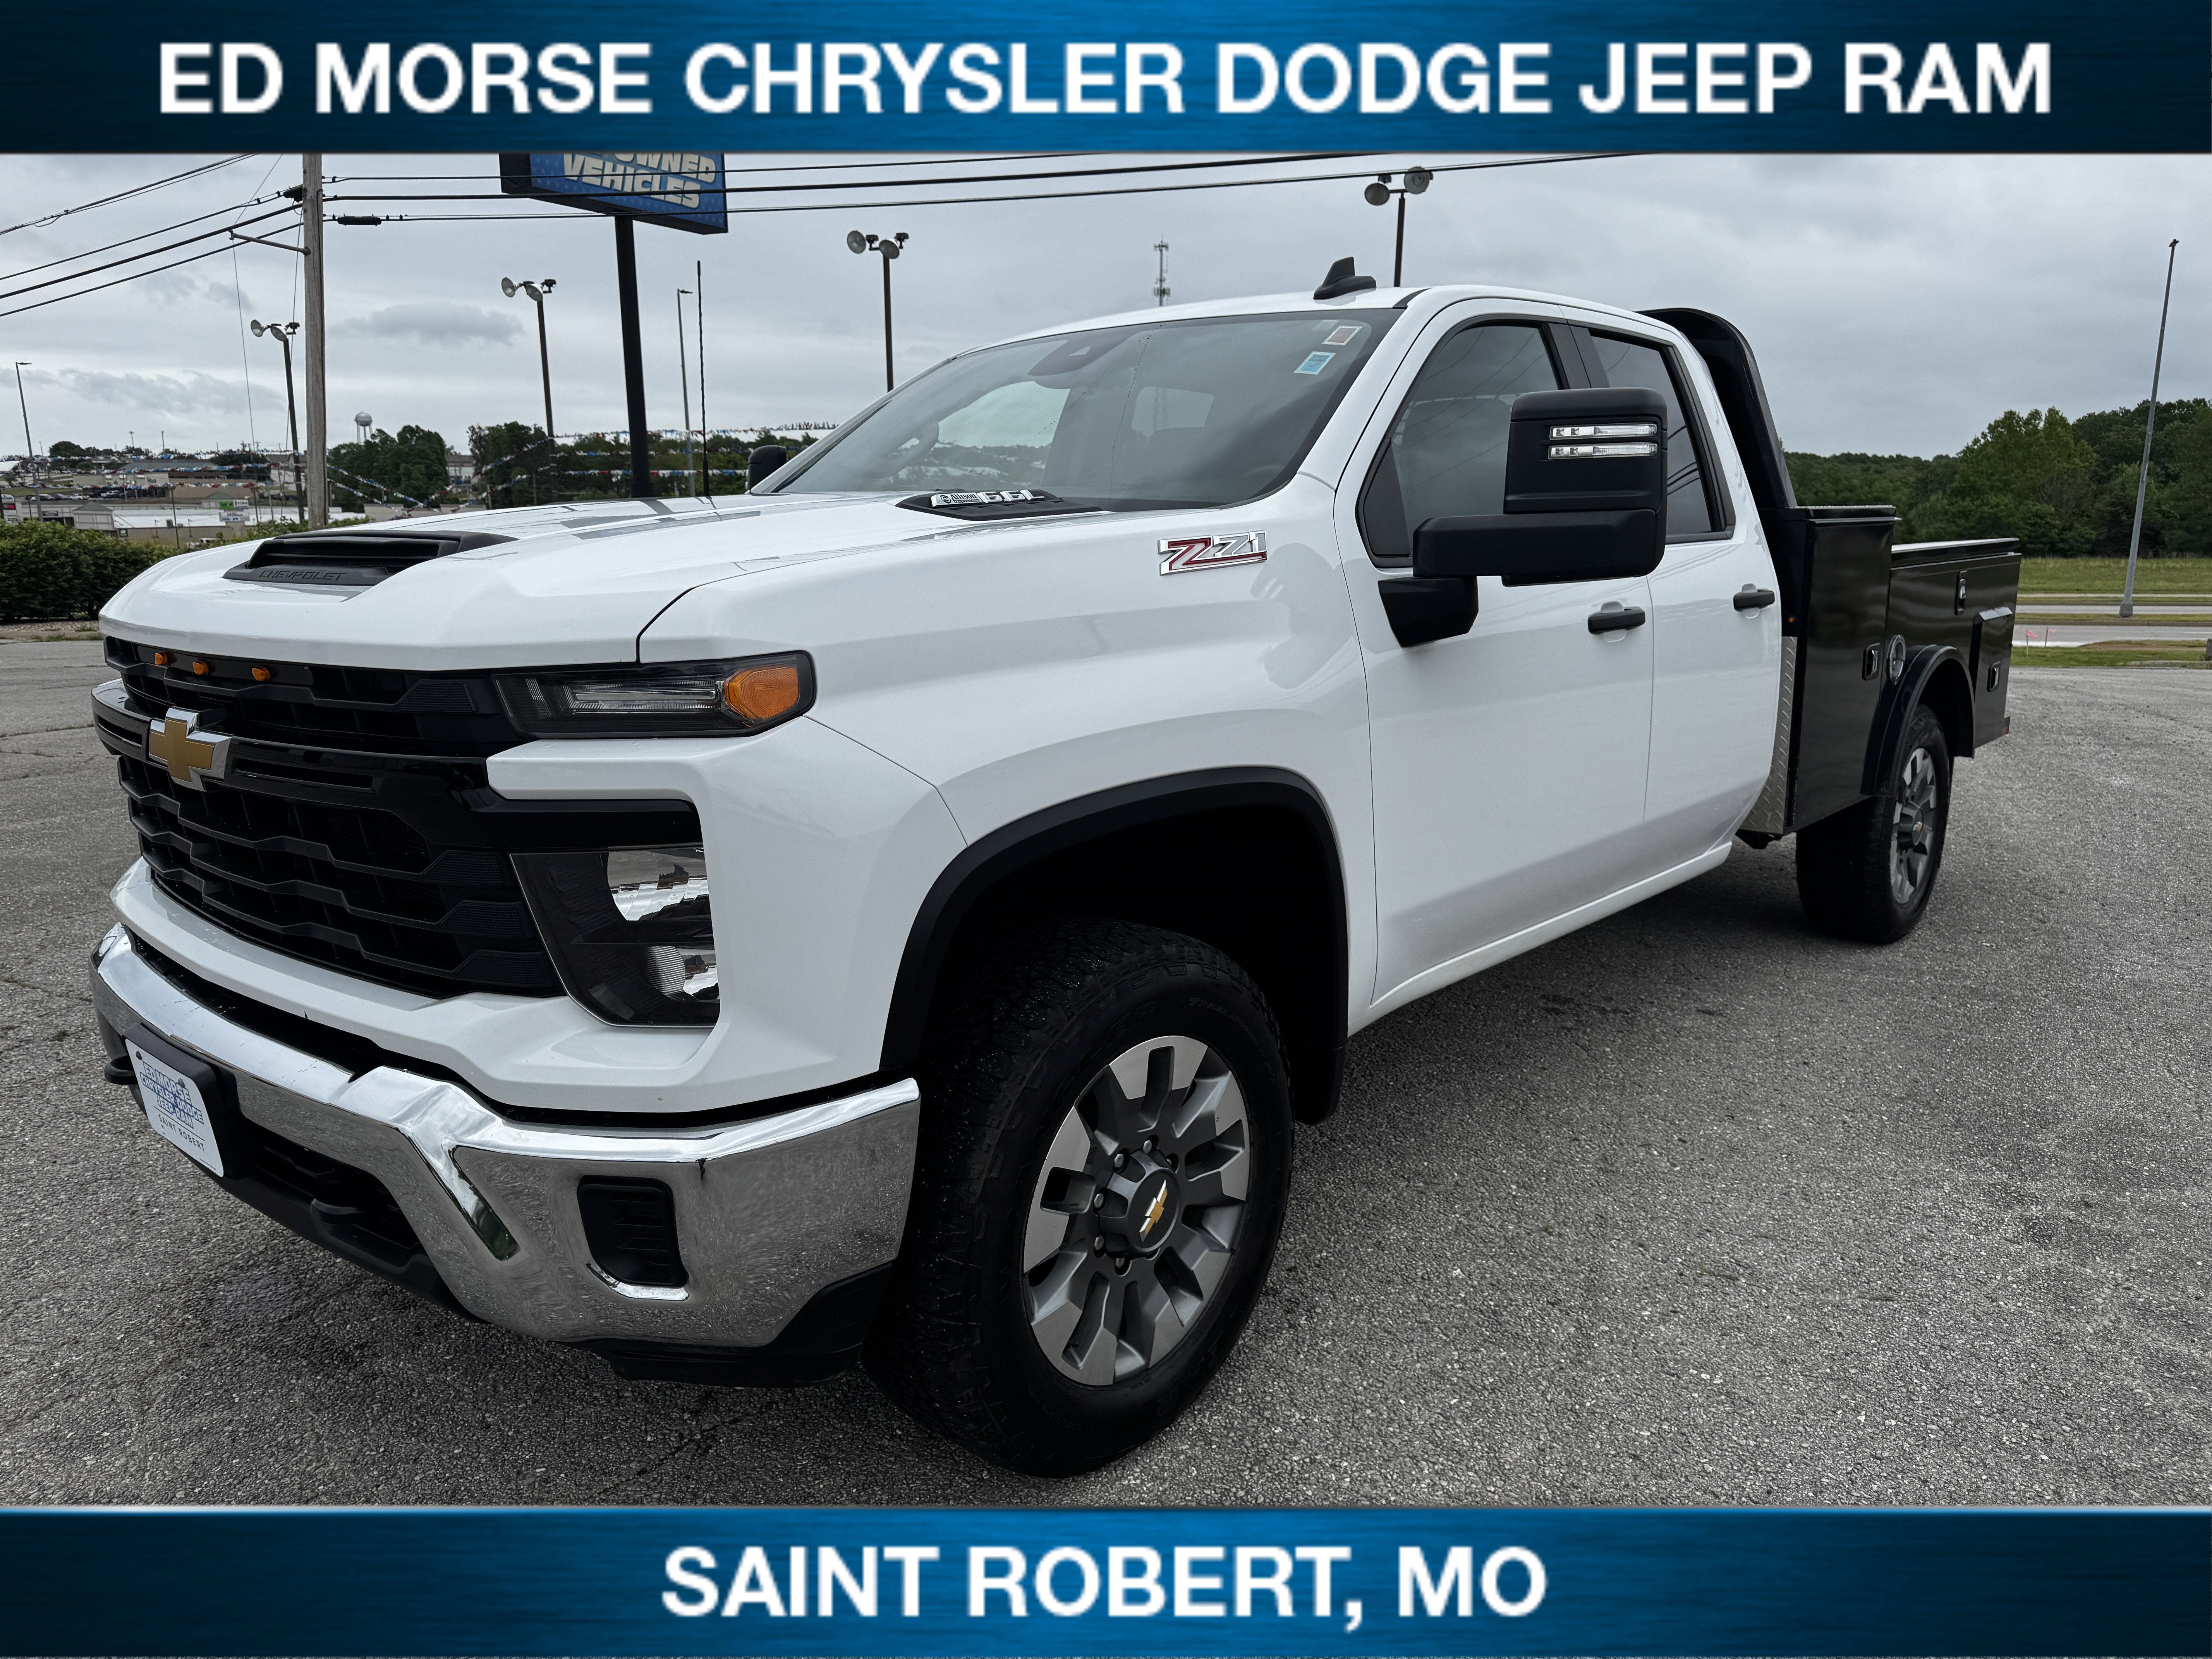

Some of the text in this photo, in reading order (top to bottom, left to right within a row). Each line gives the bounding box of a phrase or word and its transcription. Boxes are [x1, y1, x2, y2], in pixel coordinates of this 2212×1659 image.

[564, 153, 702, 208] VEHICLES
[259, 570, 347, 580] CHEVROLET
[1158, 530, 1267, 576] Z71
[140, 1072, 204, 1125] CHRYSLER DODGE
[143, 1060, 192, 1106] ED MORSE
[157, 1095, 194, 1129] JEEP RAM
[158, 1114, 204, 1151] SAINT ROBERT
